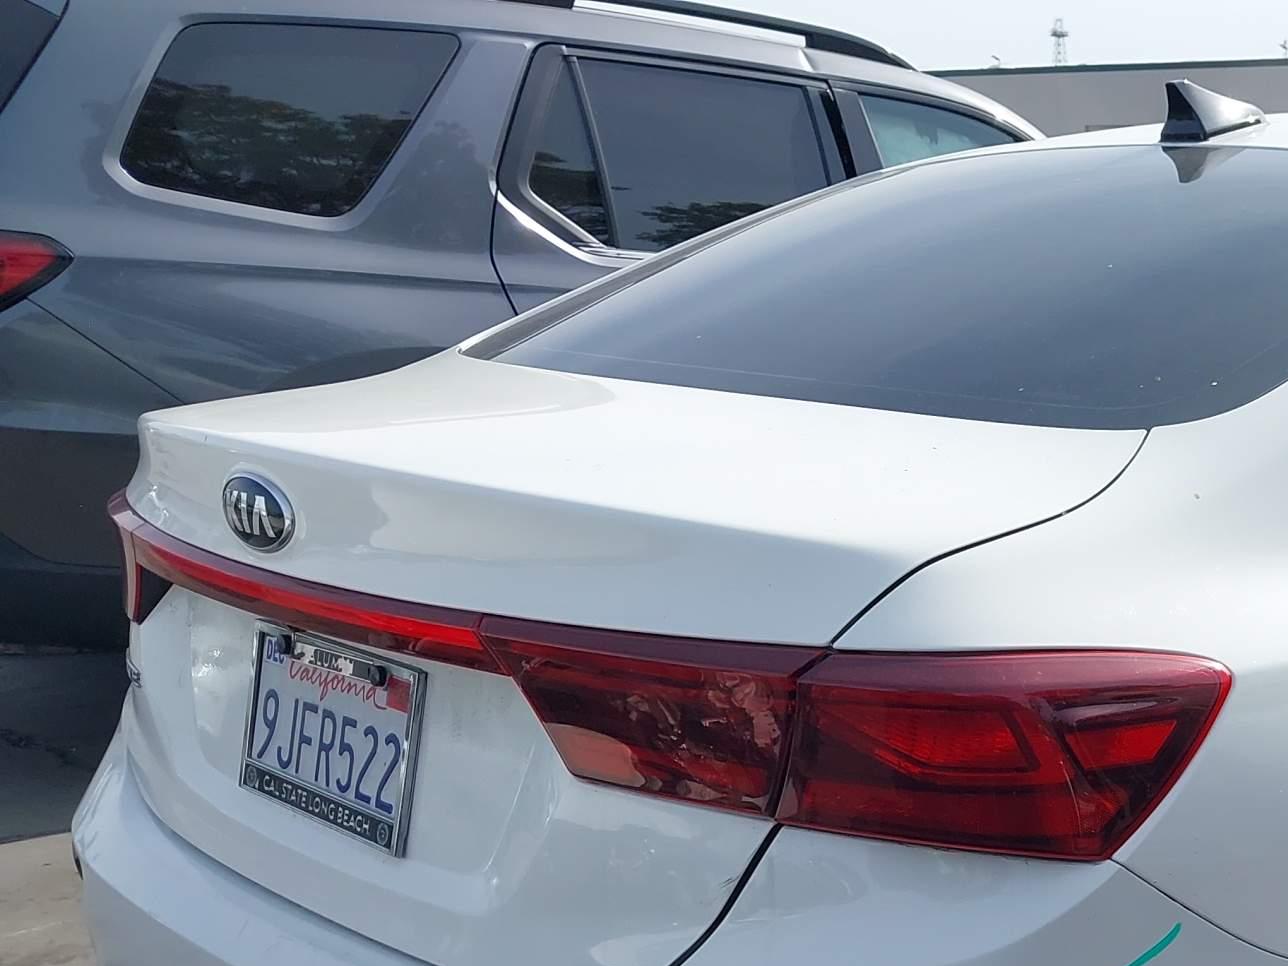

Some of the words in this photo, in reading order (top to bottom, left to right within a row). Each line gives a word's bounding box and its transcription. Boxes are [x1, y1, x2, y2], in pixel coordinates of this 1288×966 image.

[225, 488, 276, 538] KIA
[289, 659, 387, 710] California
[257, 688, 401, 815] 9JFR522
[263, 775, 279, 796] CAL
[282, 783, 307, 808] STATE
[308, 797, 335, 820] LONG
[337, 806, 370, 835] BEACH
